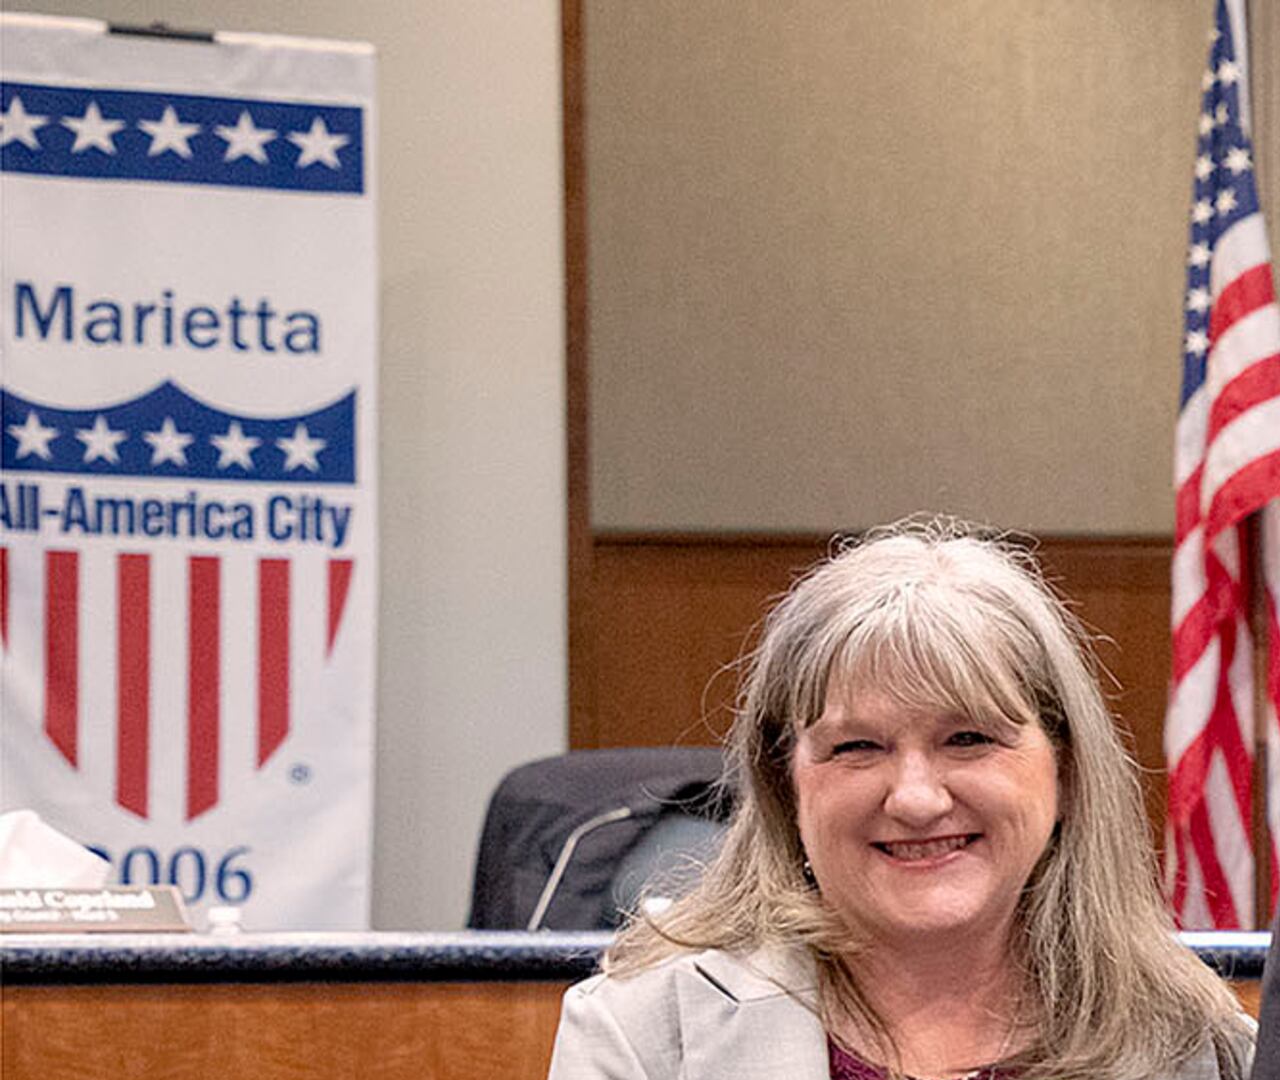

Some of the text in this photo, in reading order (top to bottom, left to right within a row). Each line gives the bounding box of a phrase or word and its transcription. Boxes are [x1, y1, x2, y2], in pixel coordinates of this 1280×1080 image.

[14, 282, 321, 353] Marietta
[0, 483, 352, 548] All-America City
[85, 844, 253, 903] 006
